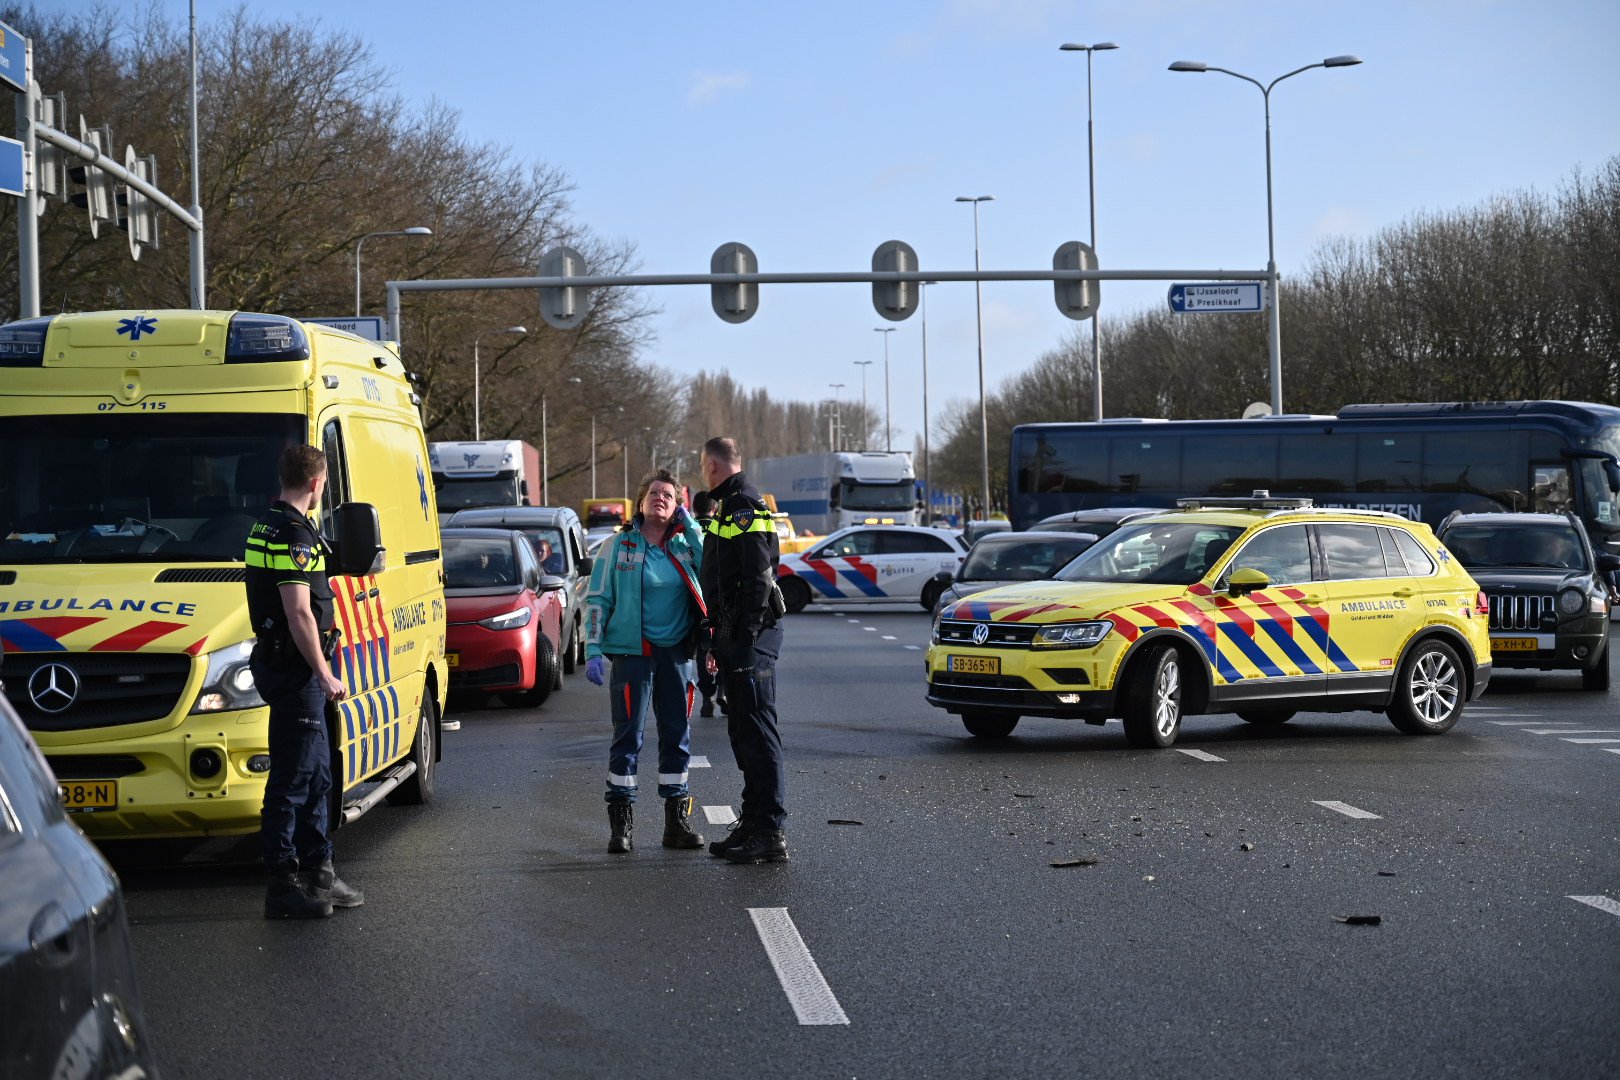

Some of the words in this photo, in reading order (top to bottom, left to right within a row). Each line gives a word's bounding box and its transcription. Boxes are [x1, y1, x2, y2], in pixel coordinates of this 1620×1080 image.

[1196, 287, 1239, 296] IJsseloord
[1197, 298, 1241, 306] Presikhaaf
[97, 402, 116, 411] 07
[140, 402, 167, 410] 115
[880, 566, 914, 575] POLITIE
[1341, 599, 1407, 613] AMBULANCE
[1426, 599, 1448, 607] 07342
[1492, 639, 1534, 649] 6-XH-KJ
[953, 658, 995, 672] SB-365-N
